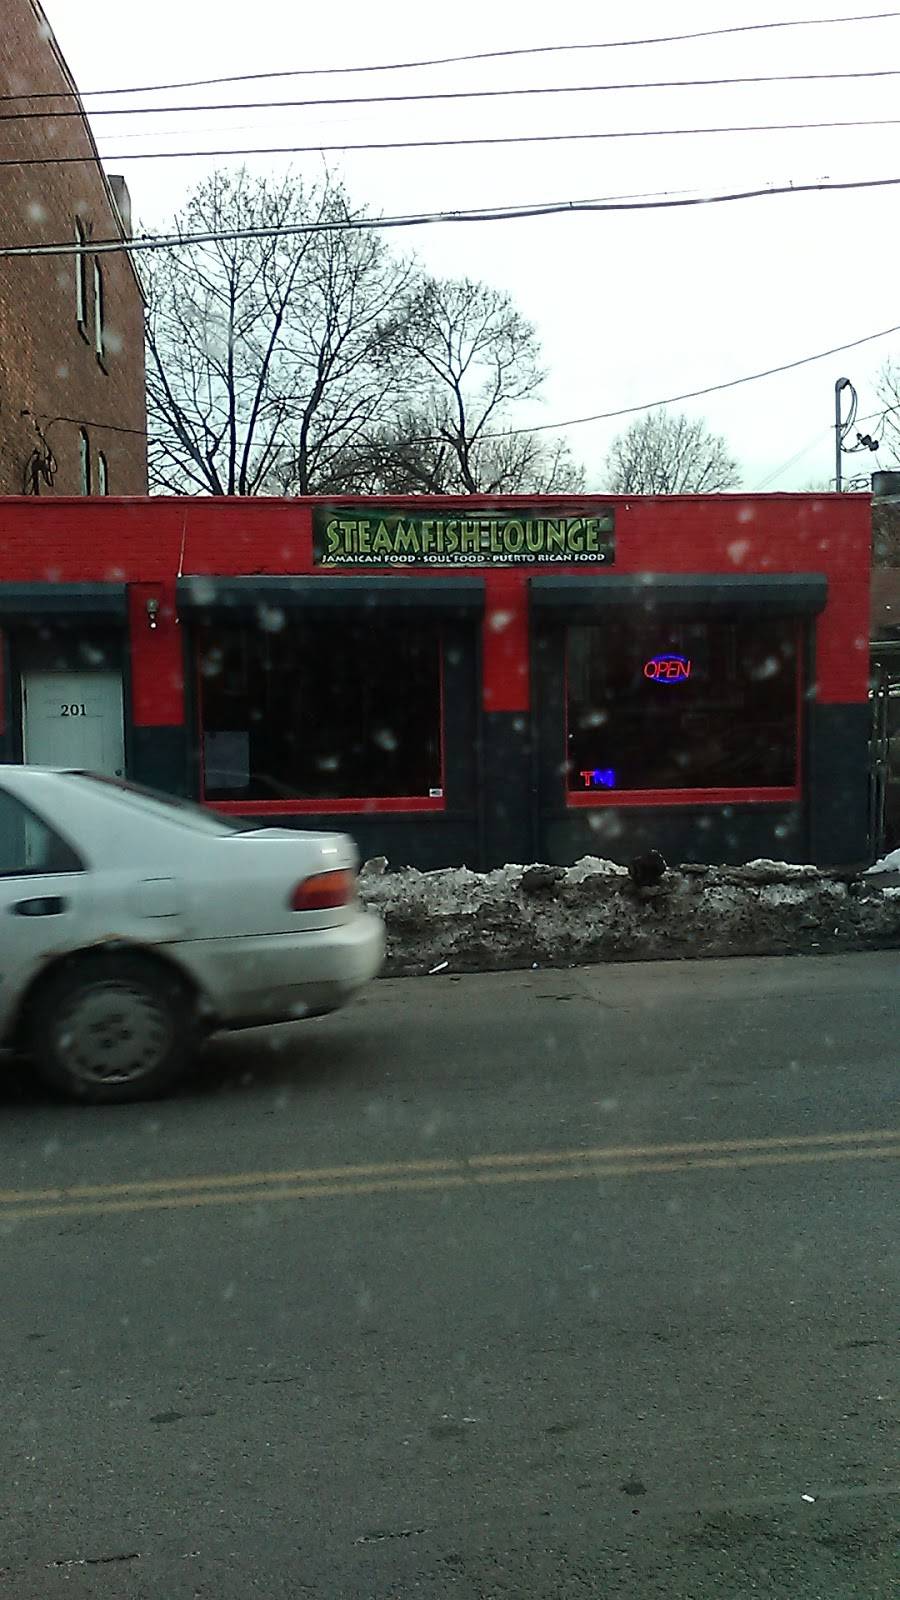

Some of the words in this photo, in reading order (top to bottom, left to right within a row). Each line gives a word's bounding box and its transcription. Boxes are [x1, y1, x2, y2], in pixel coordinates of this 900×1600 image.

[490, 519, 599, 553] LOUNGE
[321, 554, 382, 563] JAMAICAN
[384, 554, 416, 563] FOOD
[423, 554, 451, 563] SOUL
[454, 554, 485, 563] FOOD
[492, 554, 536, 562] PUERTO
[537, 554, 572, 562] RICAN
[574, 553, 605, 562] FOOD
[643, 660, 691, 678] OPEN
[60, 703, 87, 717] 201
